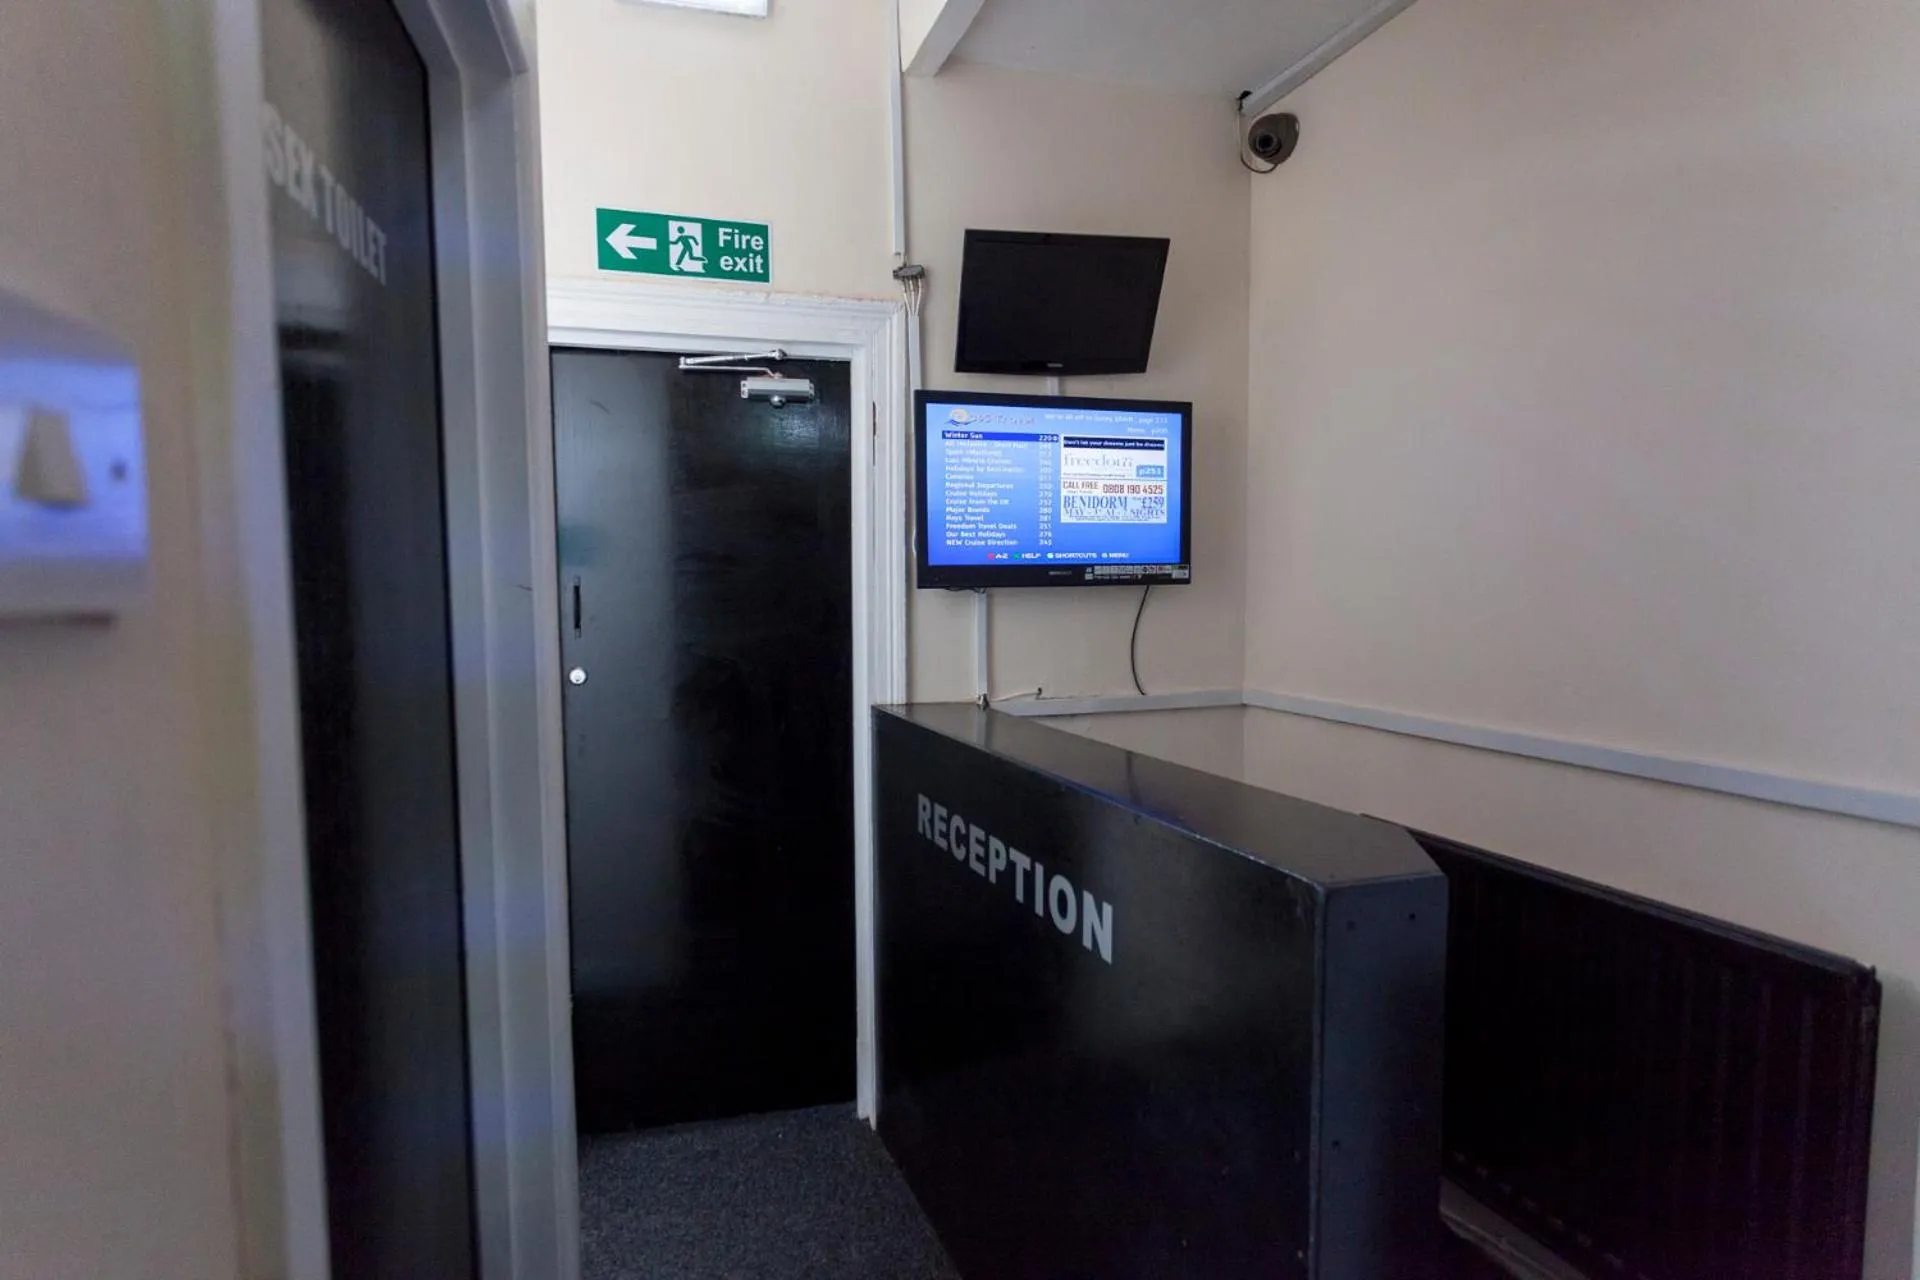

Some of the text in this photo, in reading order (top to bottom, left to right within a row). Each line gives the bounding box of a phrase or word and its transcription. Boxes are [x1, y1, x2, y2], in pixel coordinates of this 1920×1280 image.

[318, 164, 388, 286] TOILET
[718, 227, 764, 251] Fire
[719, 253, 764, 274] exit
[945, 431, 969, 439] Winter
[970, 432, 984, 440] Sun
[1089, 440, 1102, 448] your
[945, 481, 975, 490] Regional
[976, 482, 1014, 490] Departures
[1063, 481, 1099, 490] CALL FREE
[1102, 484, 1125, 494] 0808
[1127, 484, 1141, 495] 190
[1142, 485, 1164, 495] 4525
[1063, 495, 1165, 509] BENIDORM £259
[946, 506, 965, 514] Major
[977, 531, 1006, 539] Holidays
[918, 793, 1113, 965] RECEPTION
